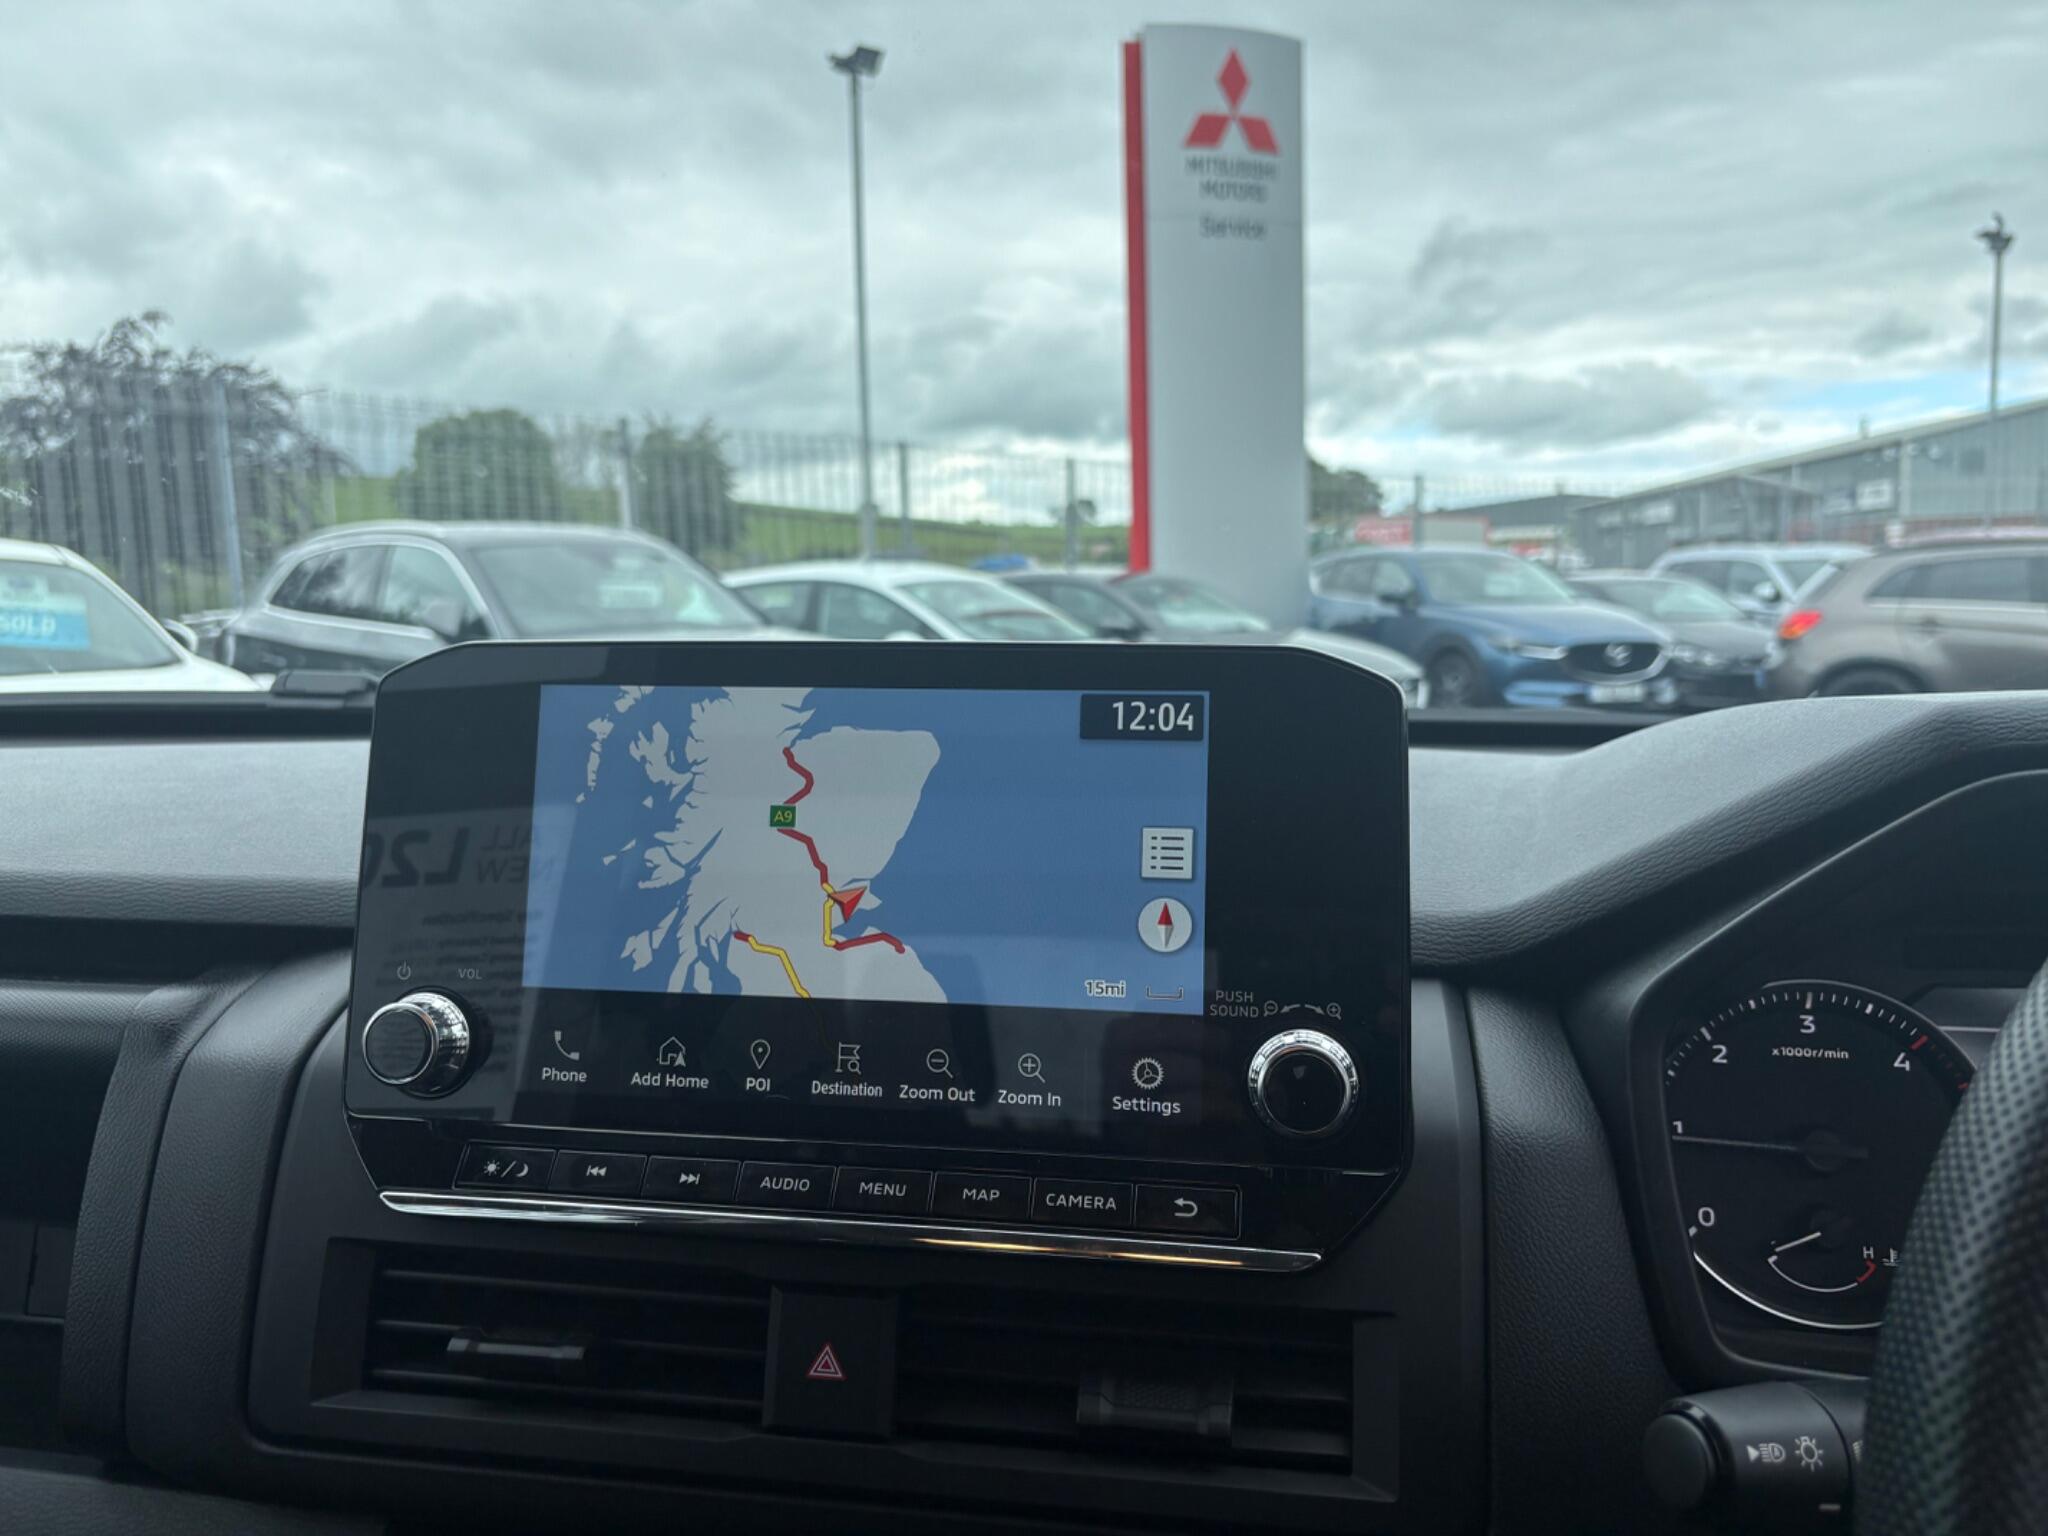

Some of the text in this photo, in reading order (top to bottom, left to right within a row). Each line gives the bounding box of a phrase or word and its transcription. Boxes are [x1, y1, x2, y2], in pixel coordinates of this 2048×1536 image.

[1184, 155, 1277, 181] MITSUBISHI
[1200, 179, 1267, 203] MOTORS
[1200, 213, 1266, 240] Service
[1111, 700, 1196, 734] 12:04
[773, 809, 794, 825] A9
[458, 968, 482, 980] VOL
[1084, 979, 1127, 998] 15mi
[1216, 990, 1254, 1003] PUSH
[1209, 1004, 1259, 1018] SOUND
[1799, 1014, 1816, 1034] 3
[1711, 1044, 1728, 1064] 2
[1771, 1046, 1850, 1060] x1000r/min
[1893, 1051, 1911, 1072] 4
[541, 1067, 588, 1082] Phone
[630, 1072, 709, 1089] Add Home
[745, 1077, 771, 1092] POI
[811, 1080, 883, 1098] Destination
[899, 1084, 976, 1102] Zoom Out
[998, 1089, 1062, 1107] Zoom In
[1112, 1096, 1182, 1117] Settings
[1672, 1120, 1683, 1134] 1
[760, 1175, 811, 1192] AUDIO
[859, 1181, 907, 1198] MENU
[962, 1187, 1000, 1202] MAP
[1045, 1193, 1117, 1211] CAMERA
[1697, 1206, 1715, 1227] 0
[1862, 1245, 1874, 1260] H
